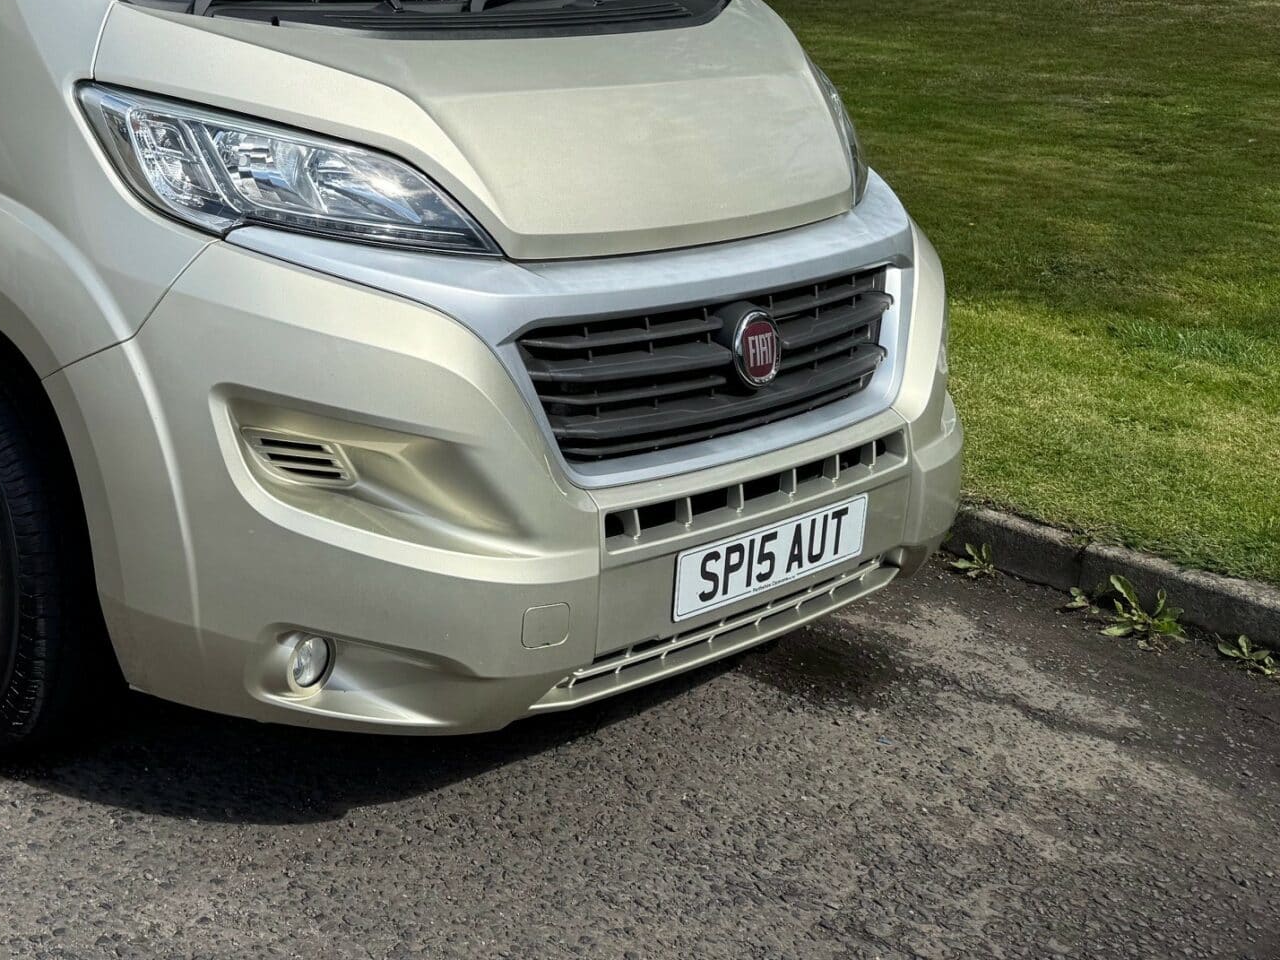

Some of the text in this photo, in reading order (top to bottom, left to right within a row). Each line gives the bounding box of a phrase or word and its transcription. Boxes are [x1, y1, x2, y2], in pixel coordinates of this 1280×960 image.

[748, 332, 772, 367] FIAT
[698, 506, 849, 603] SP15 AUT
